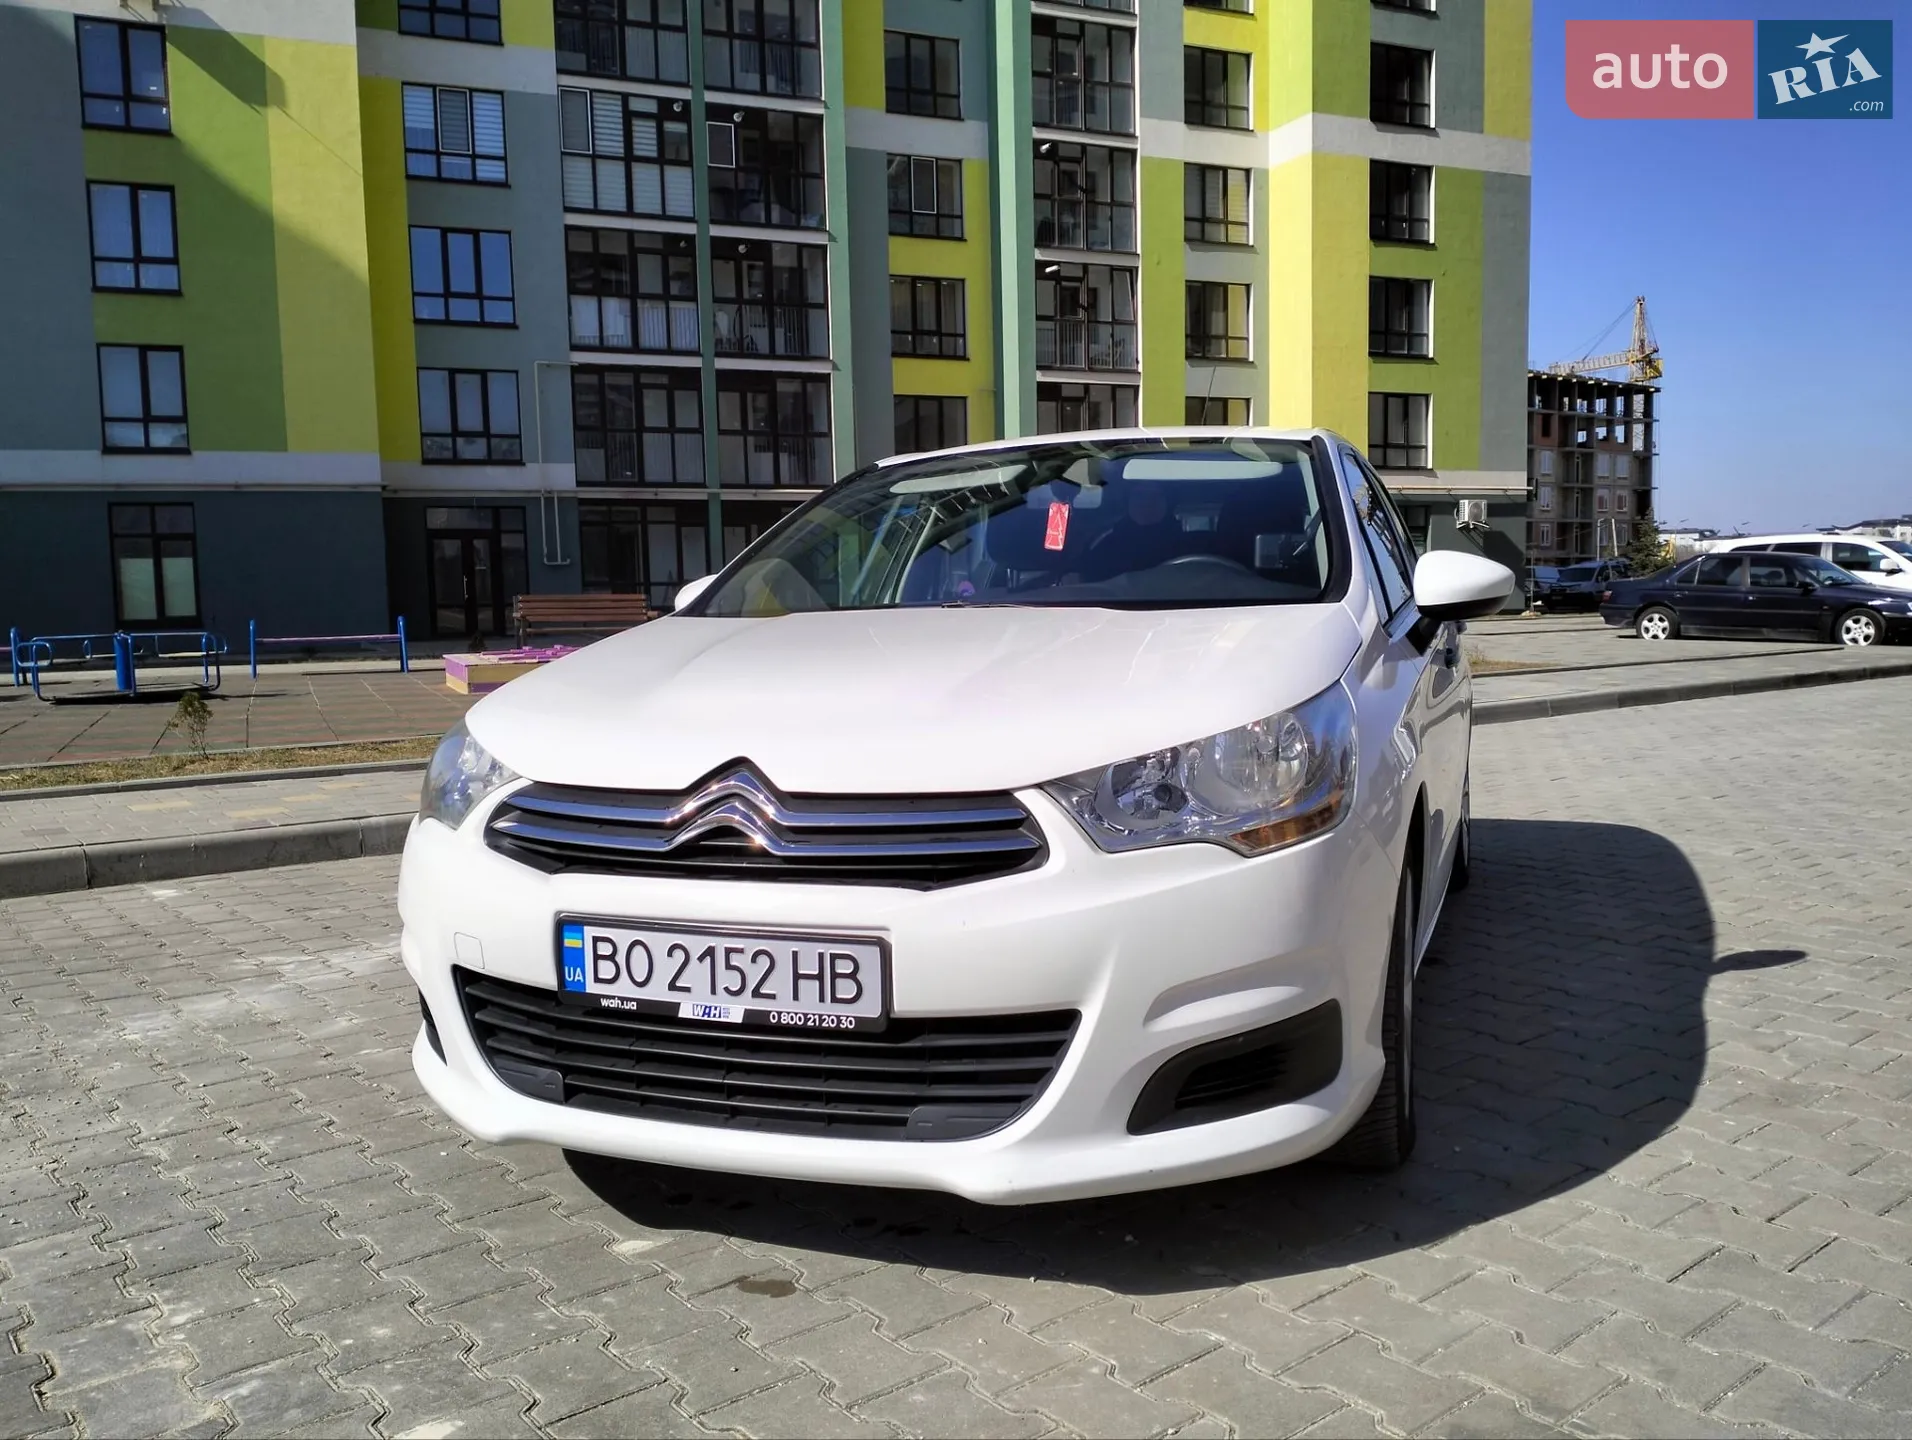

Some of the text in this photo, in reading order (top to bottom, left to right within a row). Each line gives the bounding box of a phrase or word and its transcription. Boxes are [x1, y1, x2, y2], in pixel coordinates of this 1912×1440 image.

[565, 966, 584, 983] UA
[592, 935, 864, 1005] BO 2152 HB
[600, 997, 637, 1011] wah.ua
[692, 1003, 722, 1019] WAH
[769, 1011, 855, 1029] 0 800 21 20 30
